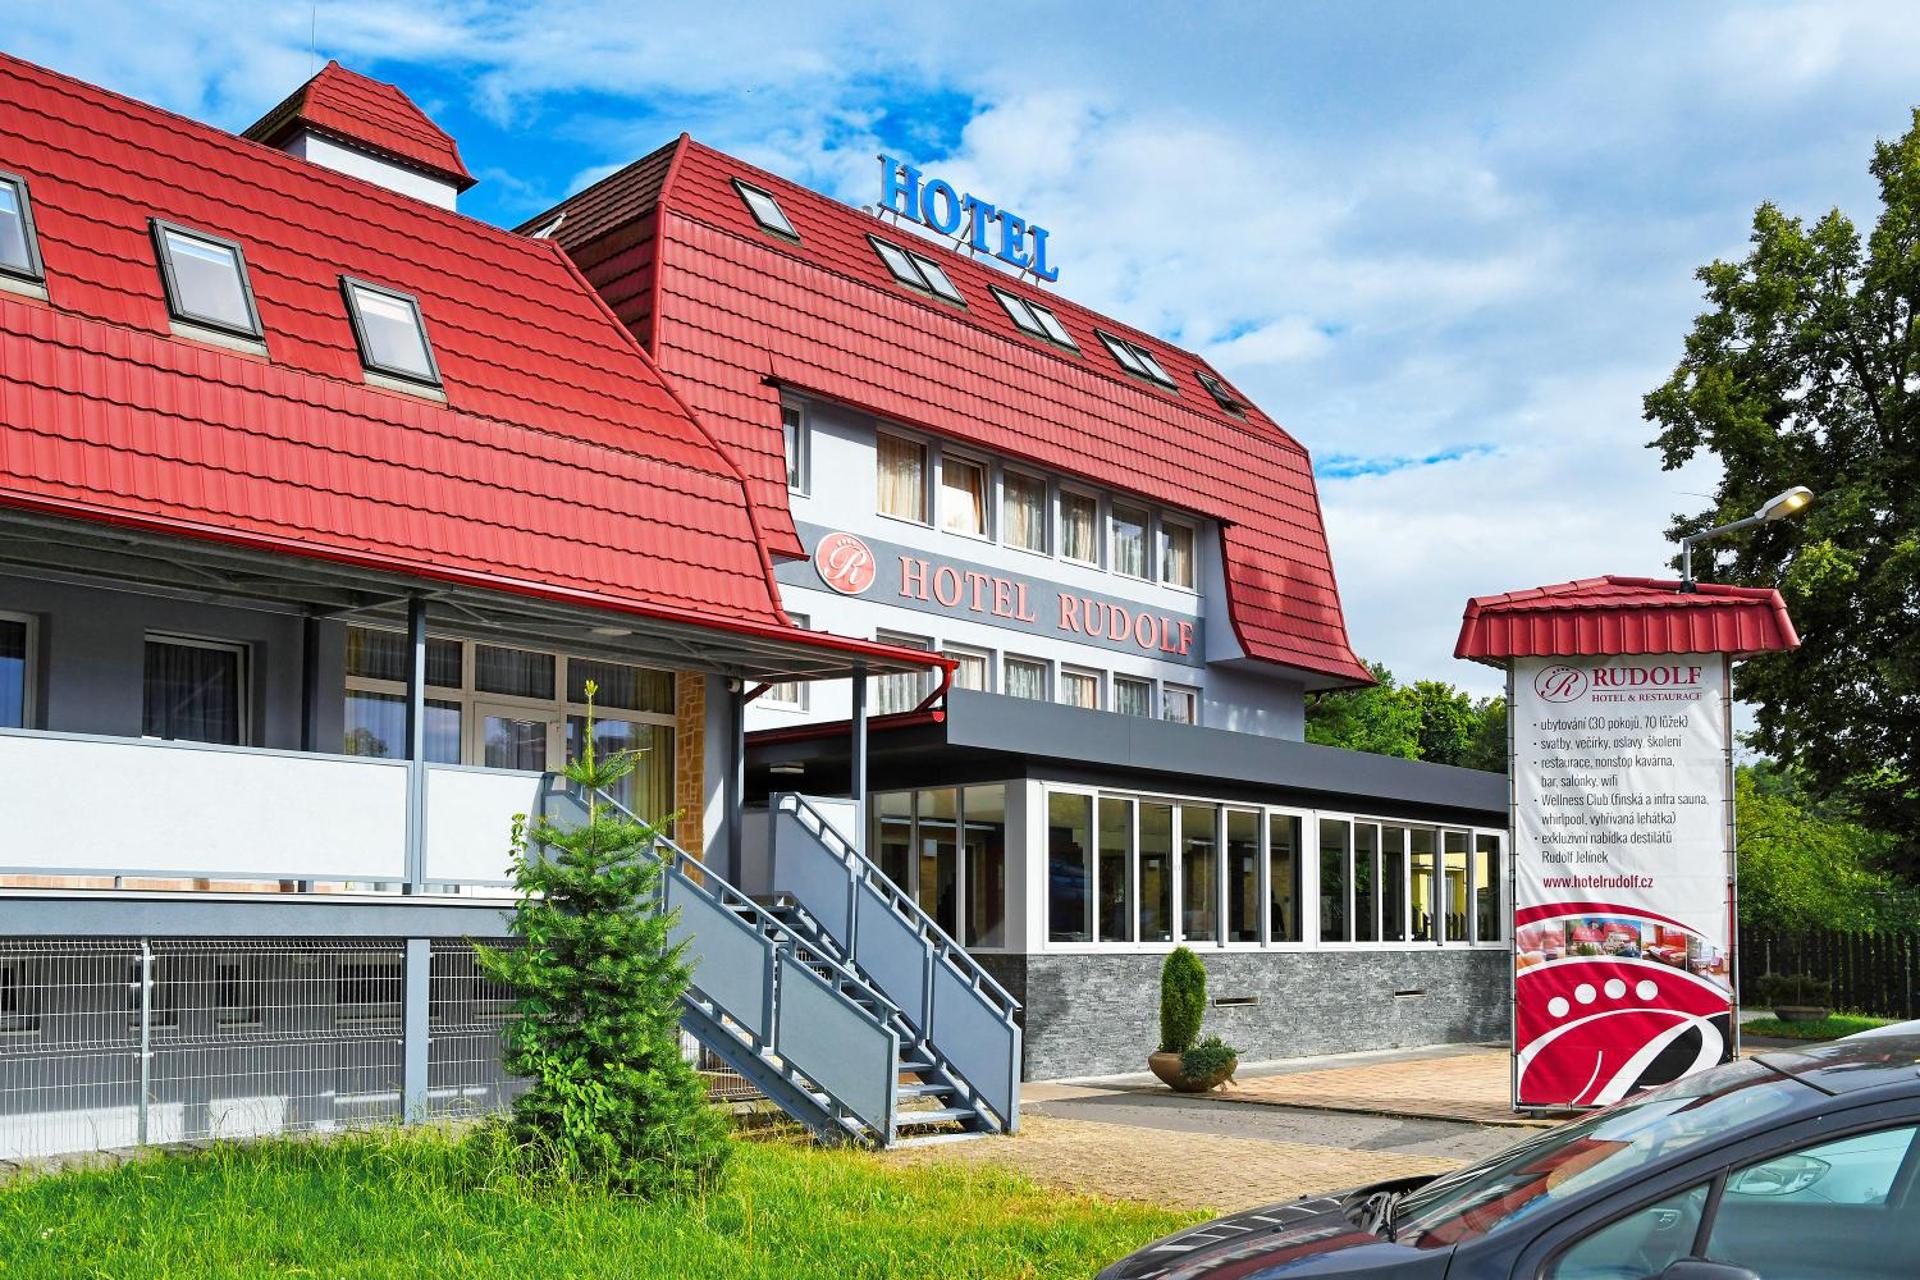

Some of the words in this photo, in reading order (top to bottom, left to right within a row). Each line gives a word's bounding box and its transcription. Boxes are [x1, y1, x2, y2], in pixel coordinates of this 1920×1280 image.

[877, 153, 1059, 283] HOTEL
[898, 555, 1035, 624] HOTEL
[1057, 592, 1193, 656] RUDOLF
[1592, 666, 1702, 687] RUDOLF
[1592, 693, 1626, 703] HOTEL
[1627, 693, 1636, 702] &
[1639, 691, 1702, 702] RESTAURACE
[1541, 715, 1587, 731] ubytování
[1588, 716, 1605, 730] (30
[1608, 715, 1643, 731] pokojů,
[1645, 715, 1657, 729] 70
[1659, 714, 1688, 729] lůžek)
[1541, 737, 1574, 751] svatby,
[1575, 736, 1611, 750] večírky,
[1647, 734, 1682, 748] školení
[1541, 755, 1593, 769] restaurace,
[1595, 755, 1633, 769] nonstop
[1635, 753, 1675, 767] kavárna,
[1541, 775, 1559, 788] bar,
[1561, 774, 1599, 789] salónky,
[1601, 774, 1618, 787] wifi
[1541, 793, 1584, 806] Wellness
[1586, 793, 1608, 806] Club
[1610, 793, 1643, 806] (finská
[1645, 795, 1652, 805] a
[1654, 793, 1675, 805] infra
[1677, 794, 1709, 806] sauna,
[1541, 813, 1587, 827] whirlpool,
[1589, 812, 1634, 826] vyhřívaná
[1637, 811, 1676, 825] lehátka)
[1541, 832, 1588, 845] exkluzivní
[1590, 832, 1628, 844] nabídka
[1630, 830, 1673, 844] destilátů
[1541, 851, 1573, 864] Rudolf
[1575, 850, 1609, 864] Jelínek
[1543, 874, 1654, 889] www.hotelrudolf.cz
